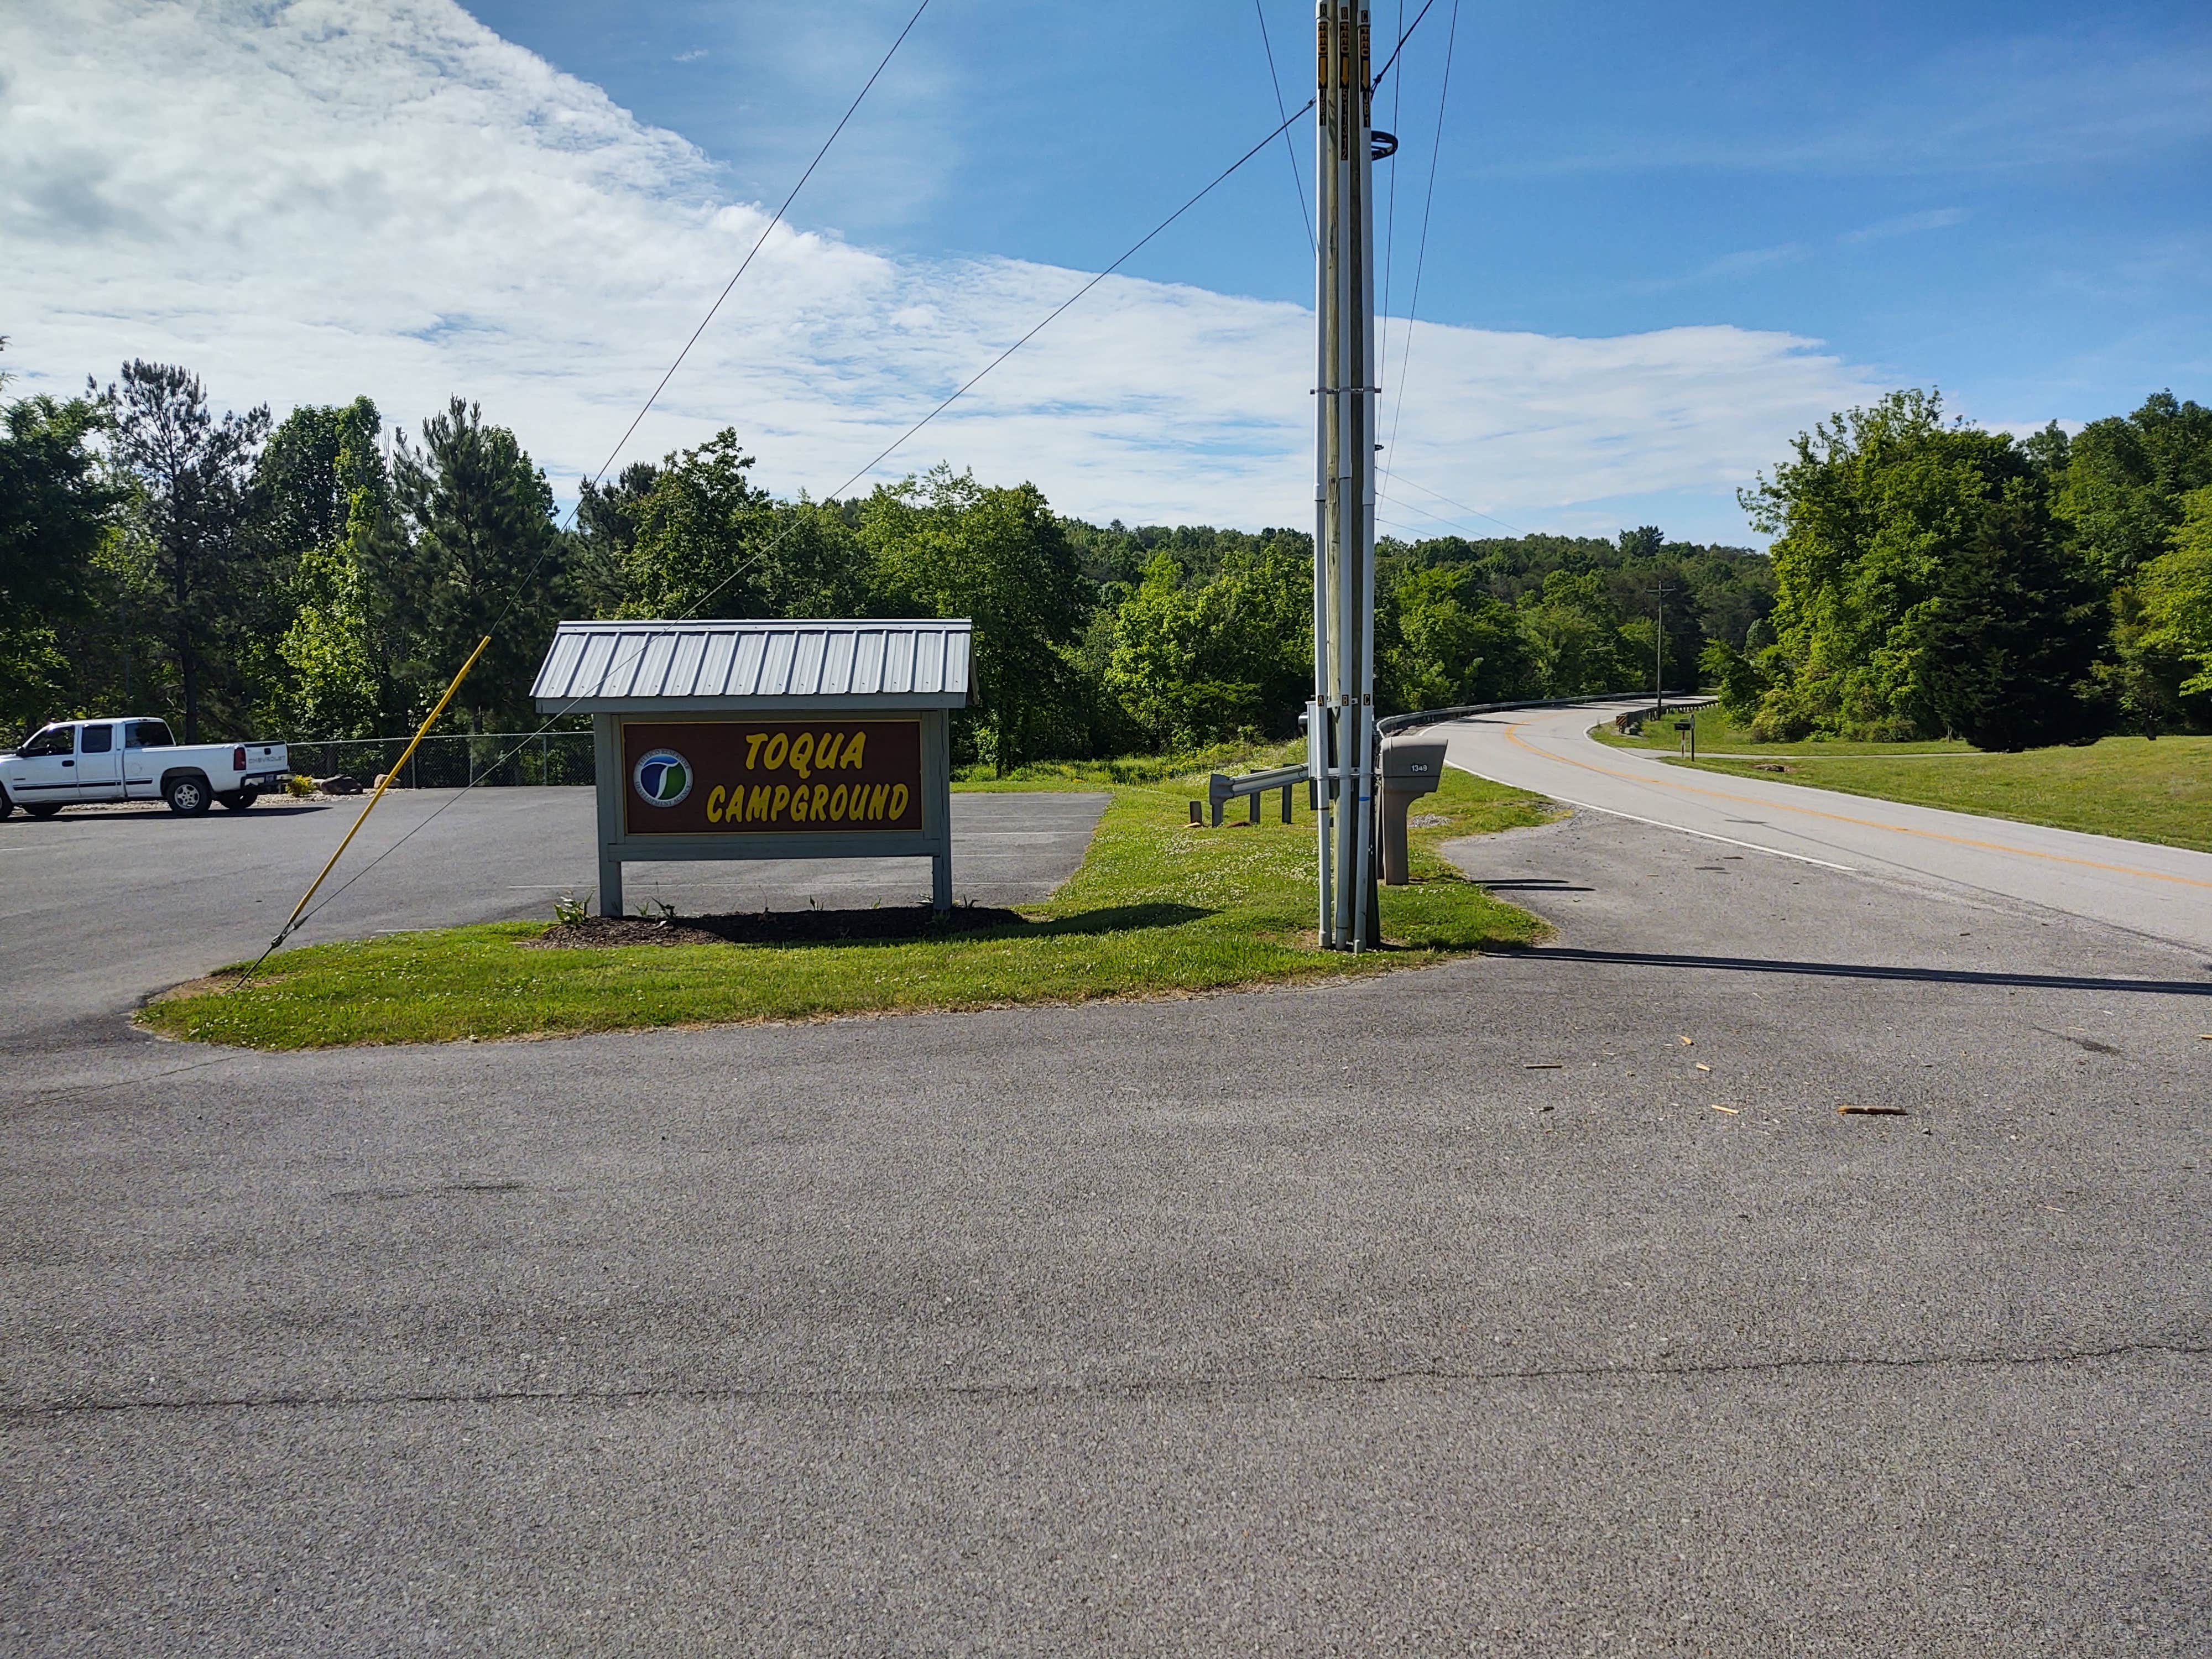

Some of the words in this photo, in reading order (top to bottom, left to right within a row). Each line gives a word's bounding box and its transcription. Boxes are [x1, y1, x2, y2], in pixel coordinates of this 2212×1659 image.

[1321, 4, 1327, 15] A
[1342, 8, 1348, 19] B
[1362, 11, 1368, 22] C
[1318, 23, 1327, 53] FEED
[1340, 23, 1349, 53] FEED
[1361, 27, 1369, 56] FEED
[1318, 696, 1323, 706] A
[1343, 696, 1348, 706] B
[1364, 695, 1370, 705] C
[638, 749, 660, 766] TELLICO
[661, 749, 690, 770] RESERVOIR
[745, 731, 867, 779] TOQUA
[635, 781, 673, 806] DEVELOPMENT
[706, 783, 910, 823] CAMPGROUND
